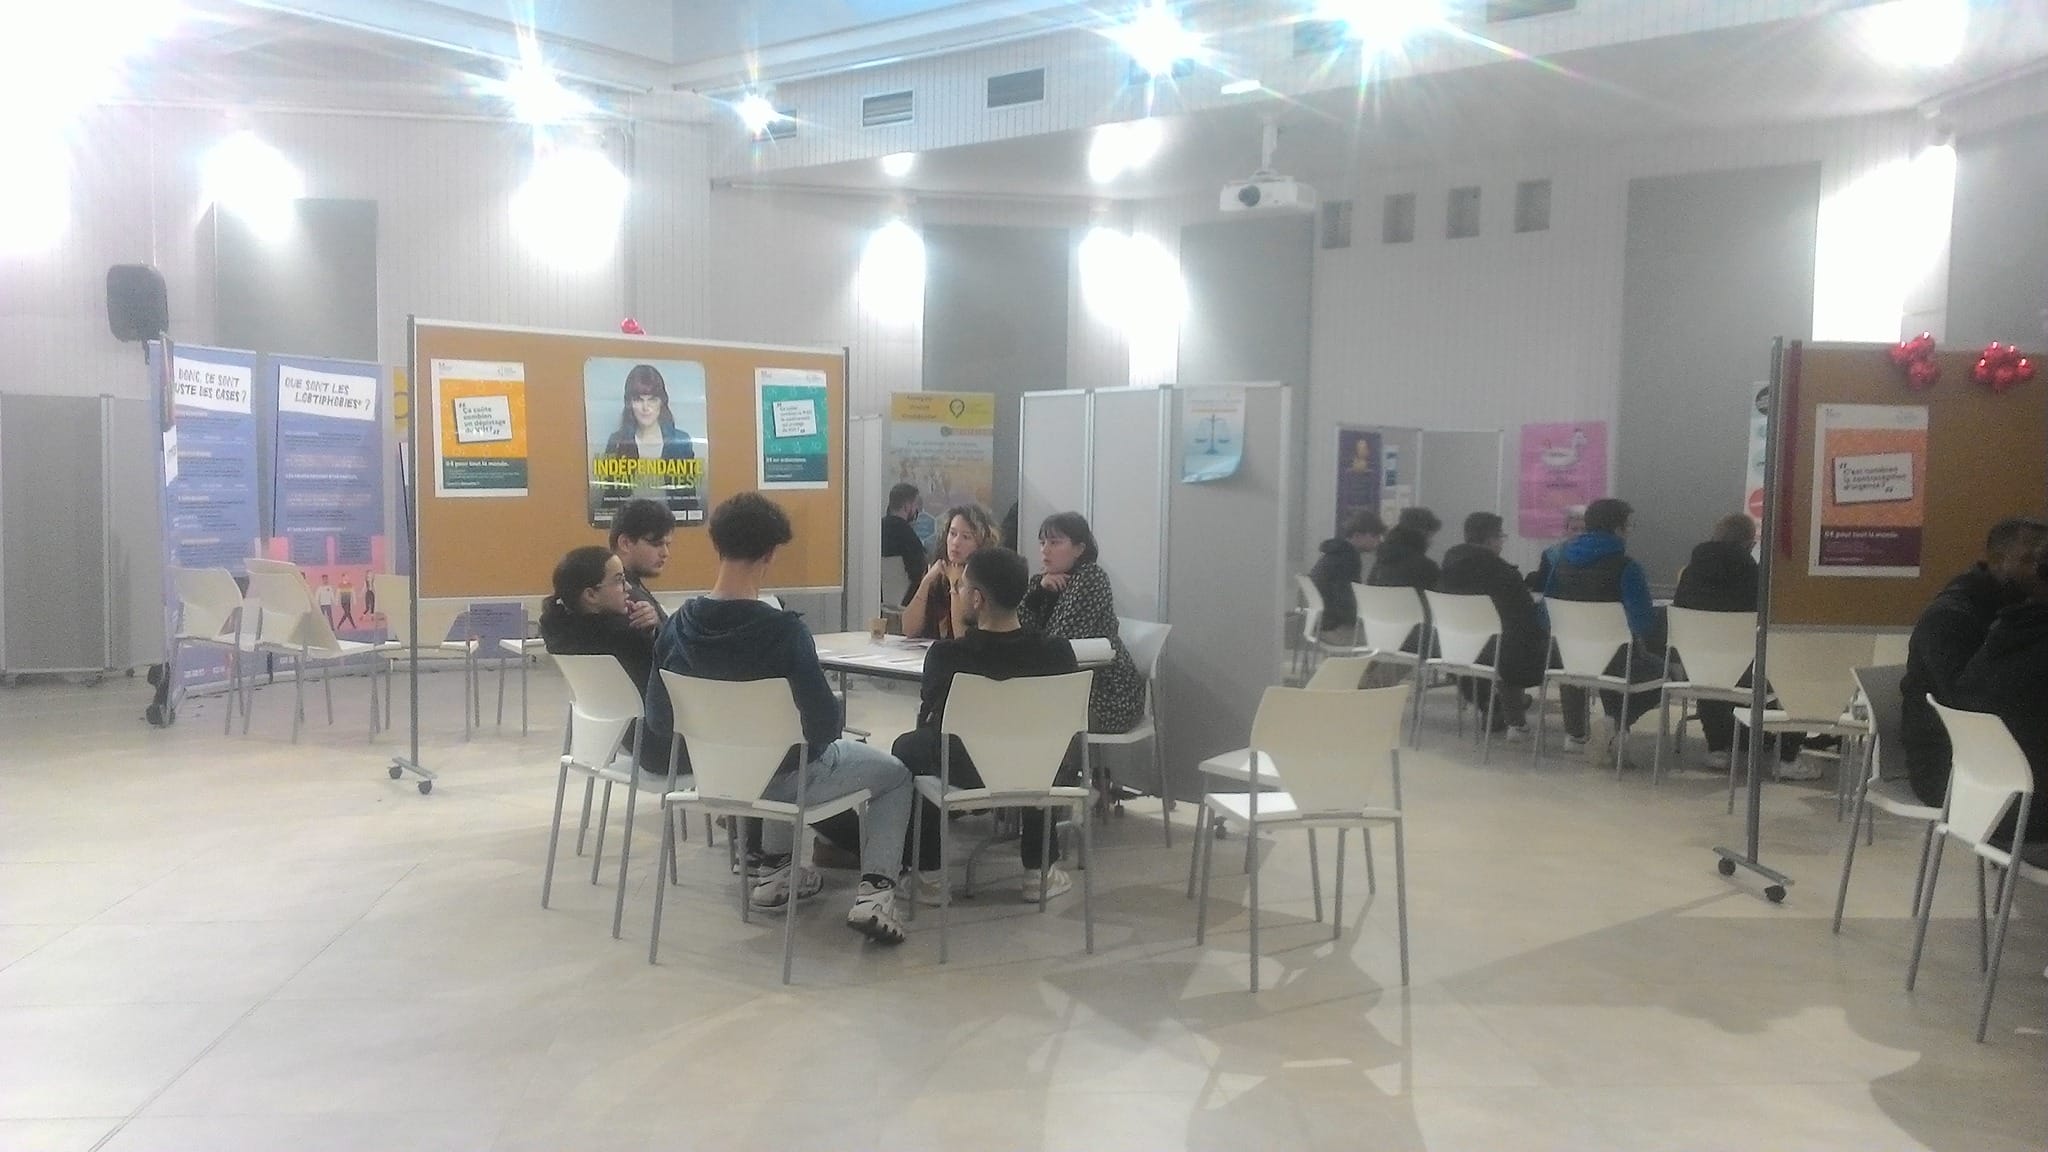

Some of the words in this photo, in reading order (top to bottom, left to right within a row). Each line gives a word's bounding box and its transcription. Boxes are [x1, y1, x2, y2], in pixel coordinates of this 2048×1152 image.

[206, 373, 215, 384] CE
[218, 375, 239, 388] SONT
[285, 377, 302, 389] QUE
[306, 380, 329, 392] SONT
[332, 383, 349, 395] LES
[174, 383, 196, 395] USTE
[216, 388, 239, 401] CASES
[242, 390, 247, 403] ?
[364, 399, 371, 411] ?
[594, 455, 703, 475] INDÉPENDANTE
